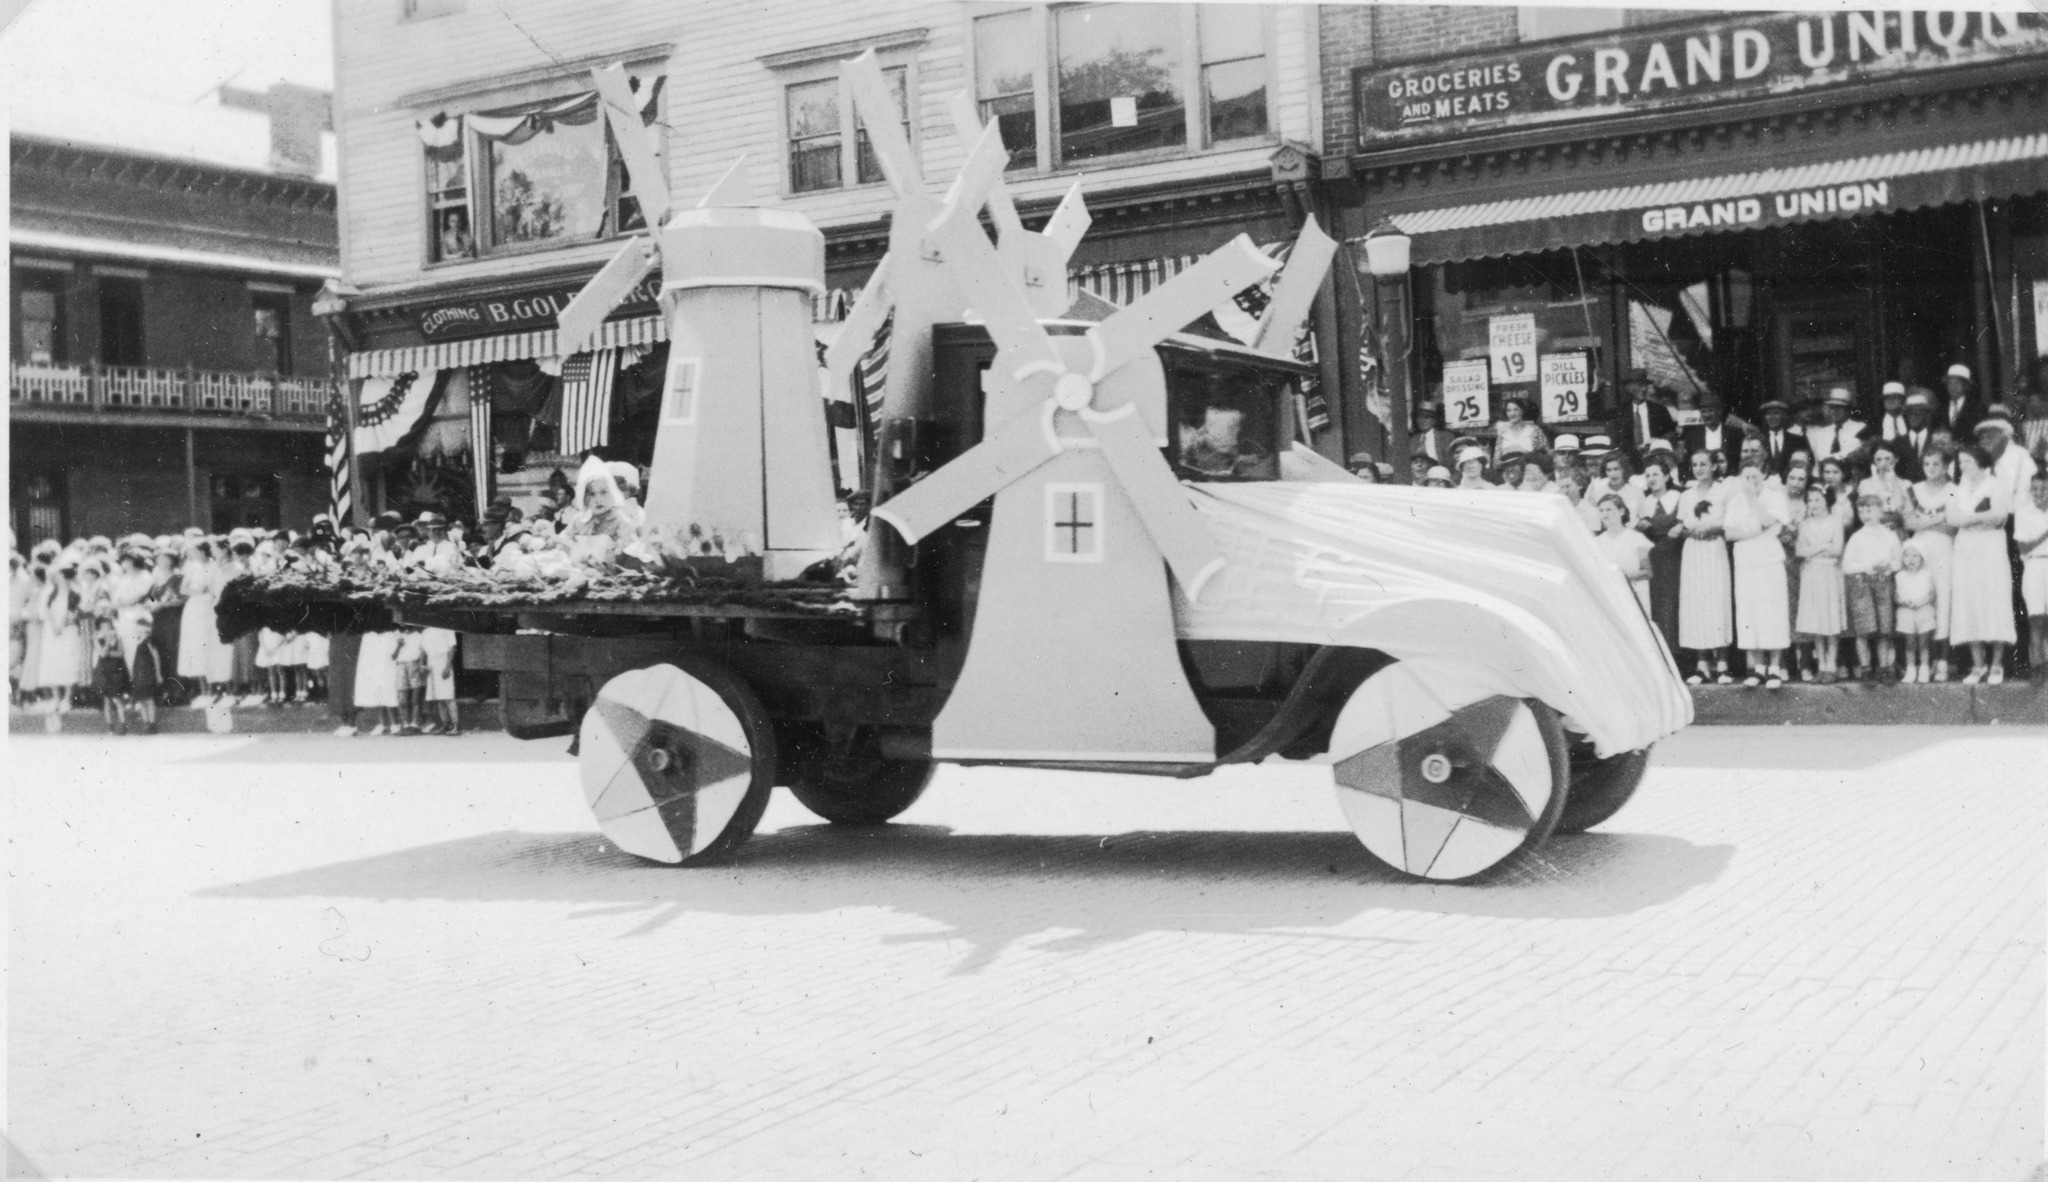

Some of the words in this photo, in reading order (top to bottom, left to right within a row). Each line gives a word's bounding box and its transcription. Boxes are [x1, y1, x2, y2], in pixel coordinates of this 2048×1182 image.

[1546, 29, 1771, 101] GRAND
[1797, 12, 2018, 68] UNION
[1388, 63, 1521, 98] GROCERIES
[1402, 102, 1431, 118] AND
[1435, 91, 1510, 118] MEATS
[1642, 199, 1761, 232] GRAND
[1775, 181, 1888, 217] UNION
[422, 307, 480, 334] CLOTHING
[1496, 322, 1528, 332] FRESH
[1492, 332, 1532, 347] CHEESE
[1502, 352, 1525, 377] 19
[1551, 362, 1576, 372] DILL
[1544, 371, 1585, 386] PICKLES
[1454, 396, 1480, 421] 25
[1554, 390, 1579, 416] 29
